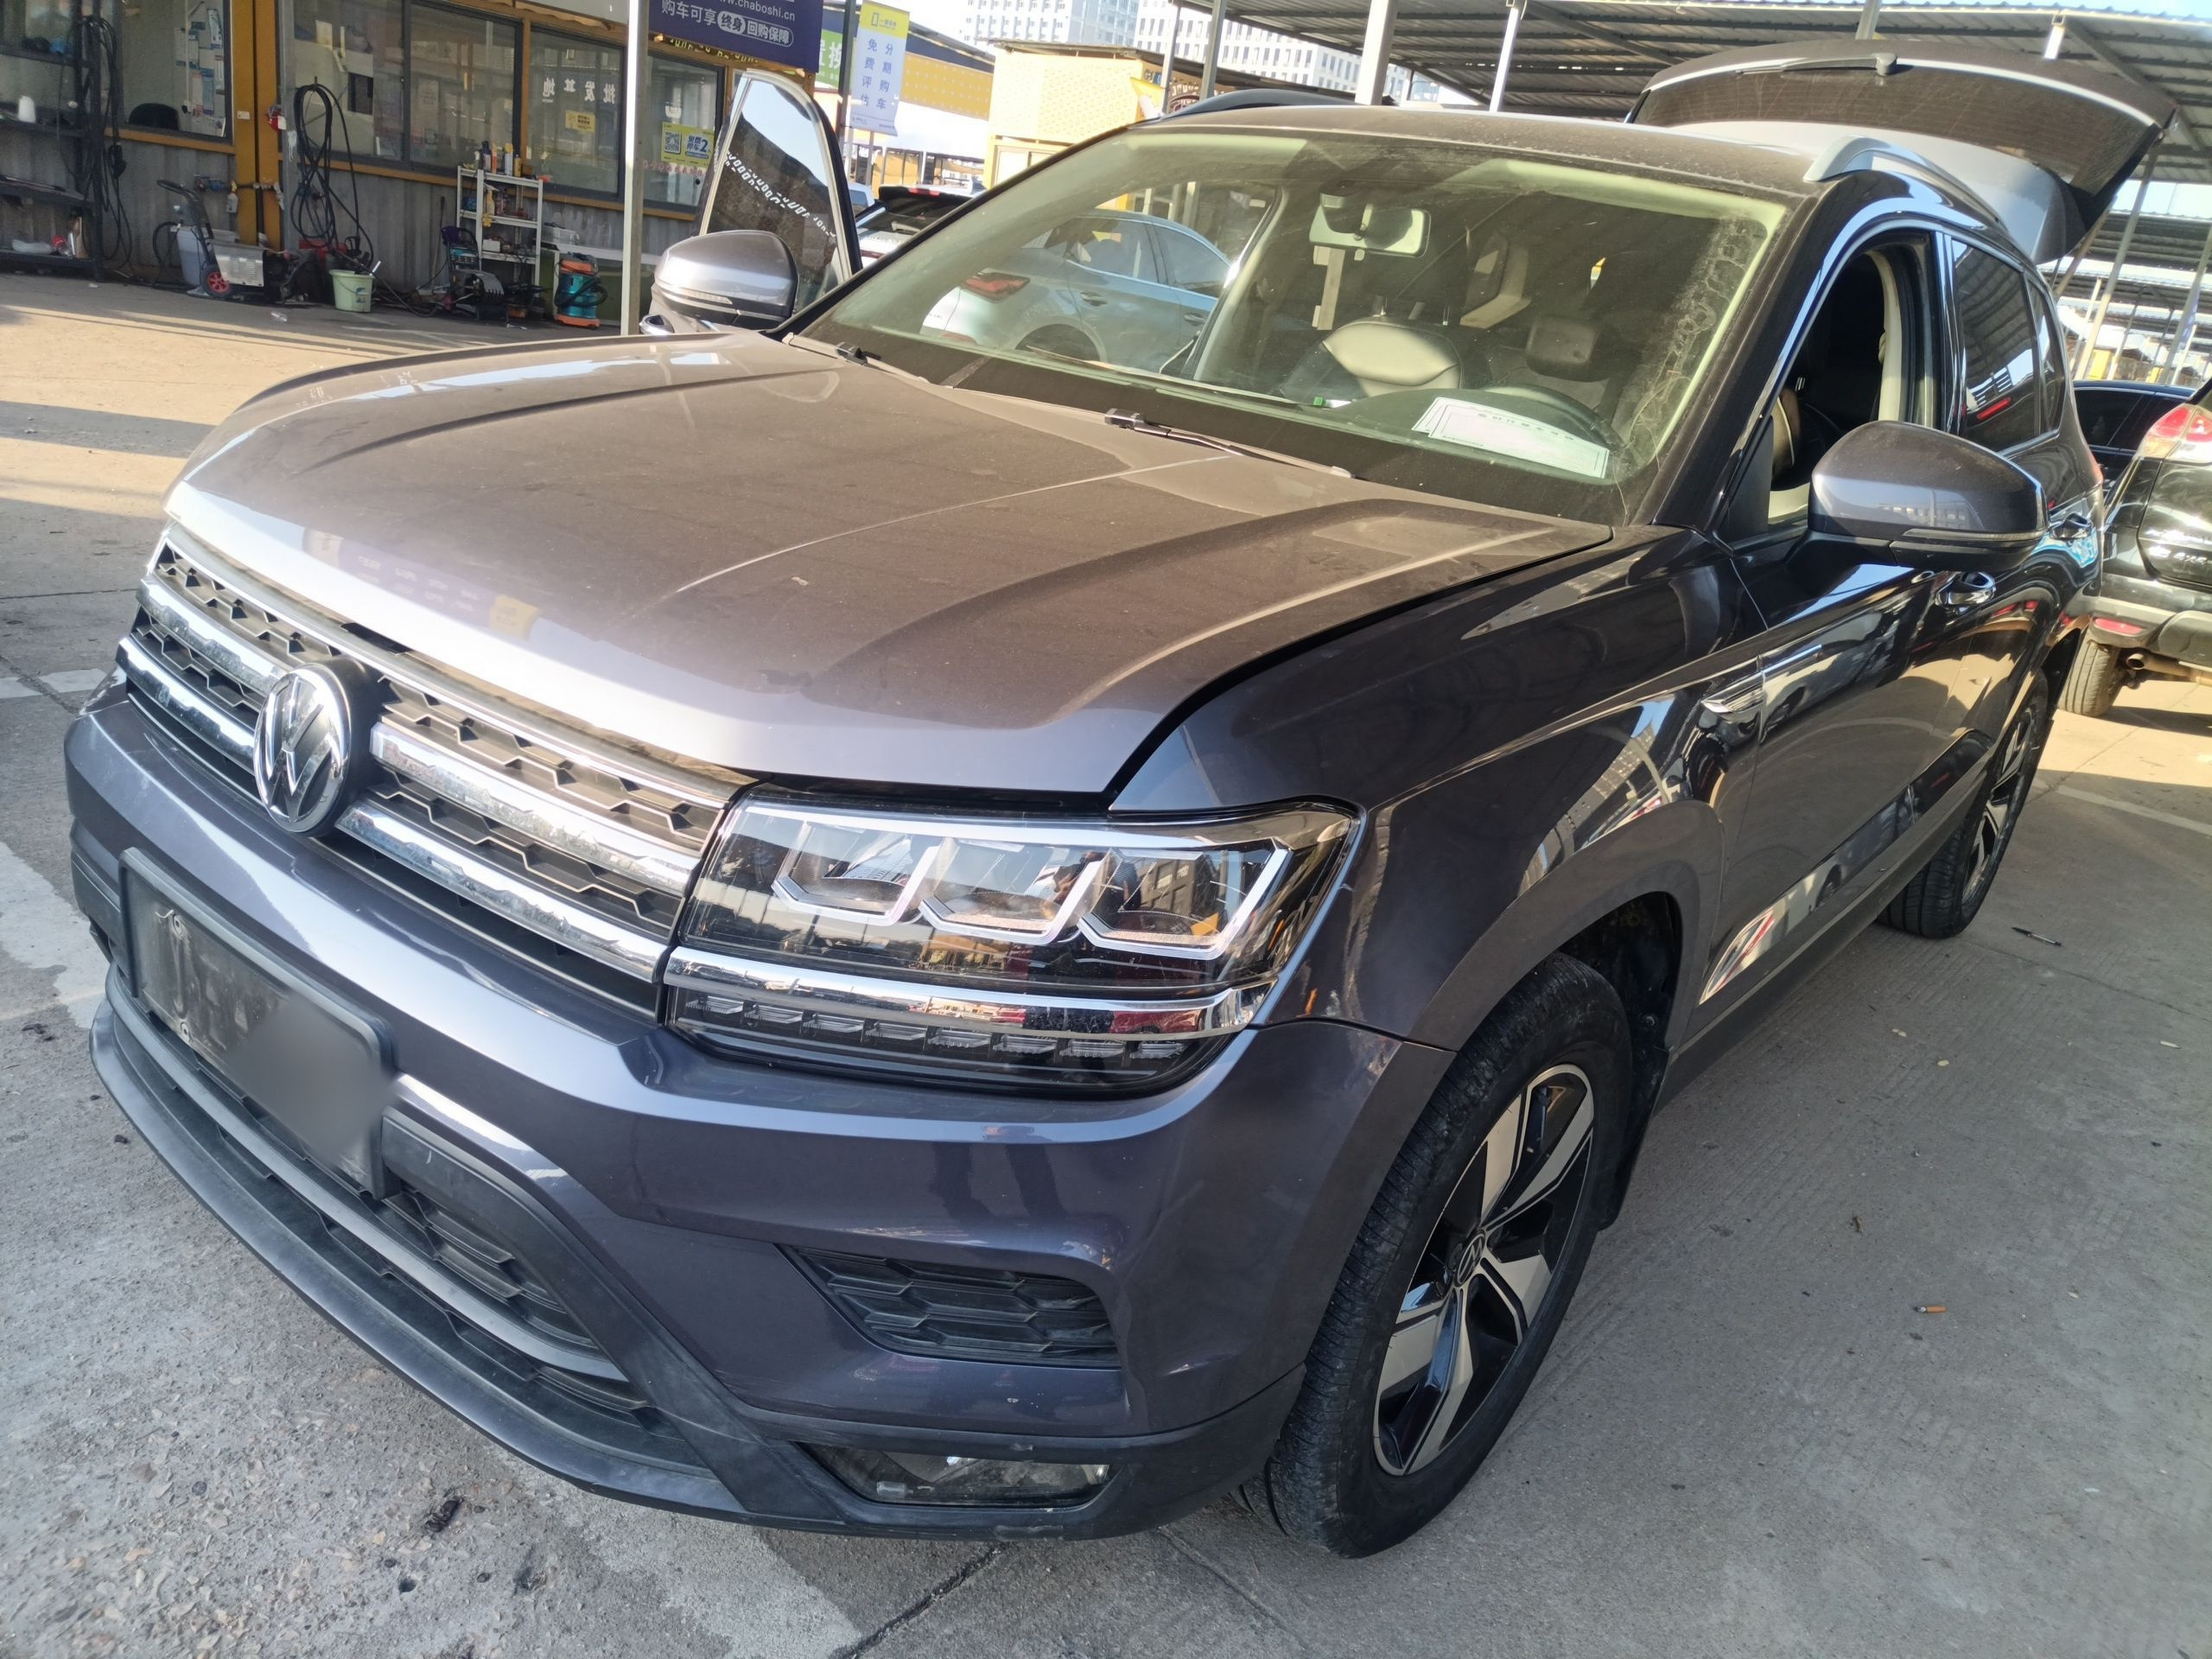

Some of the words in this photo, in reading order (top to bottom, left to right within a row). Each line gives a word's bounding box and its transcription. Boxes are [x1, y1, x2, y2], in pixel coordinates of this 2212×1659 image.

[861, 39, 877, 107] 免费评估
[876, 43, 893, 109] 分期购车
